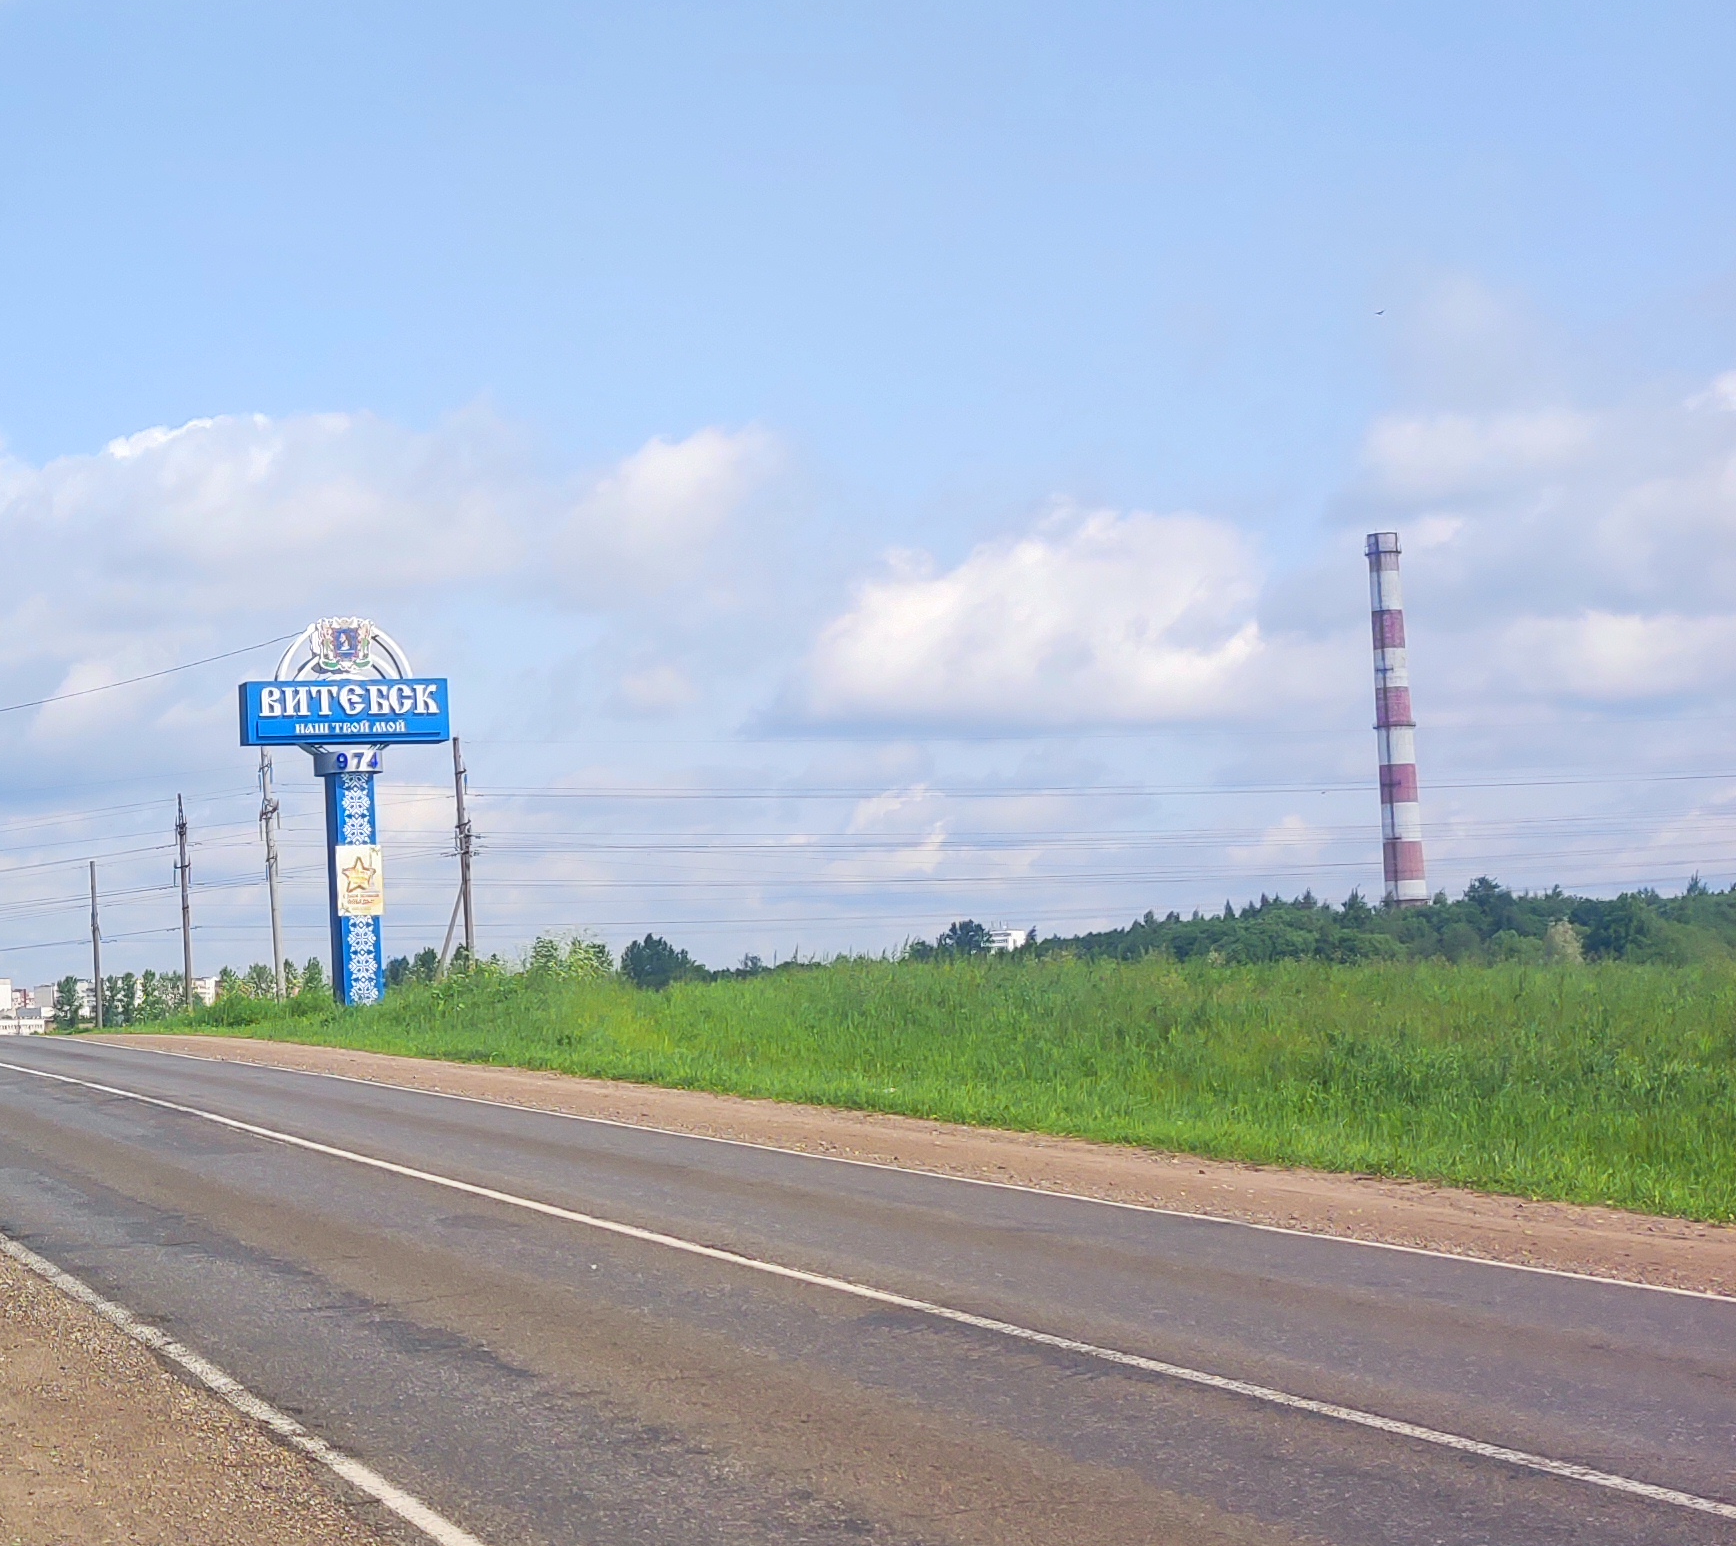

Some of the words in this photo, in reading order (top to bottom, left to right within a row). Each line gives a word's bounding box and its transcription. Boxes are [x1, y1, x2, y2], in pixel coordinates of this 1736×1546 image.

[258, 684, 440, 717] ВИТЕБСК
[295, 723, 329, 734] НАШ
[331, 720, 370, 734] ТВОЙ
[372, 719, 406, 733] МОЙ
[337, 752, 379, 770] 974
